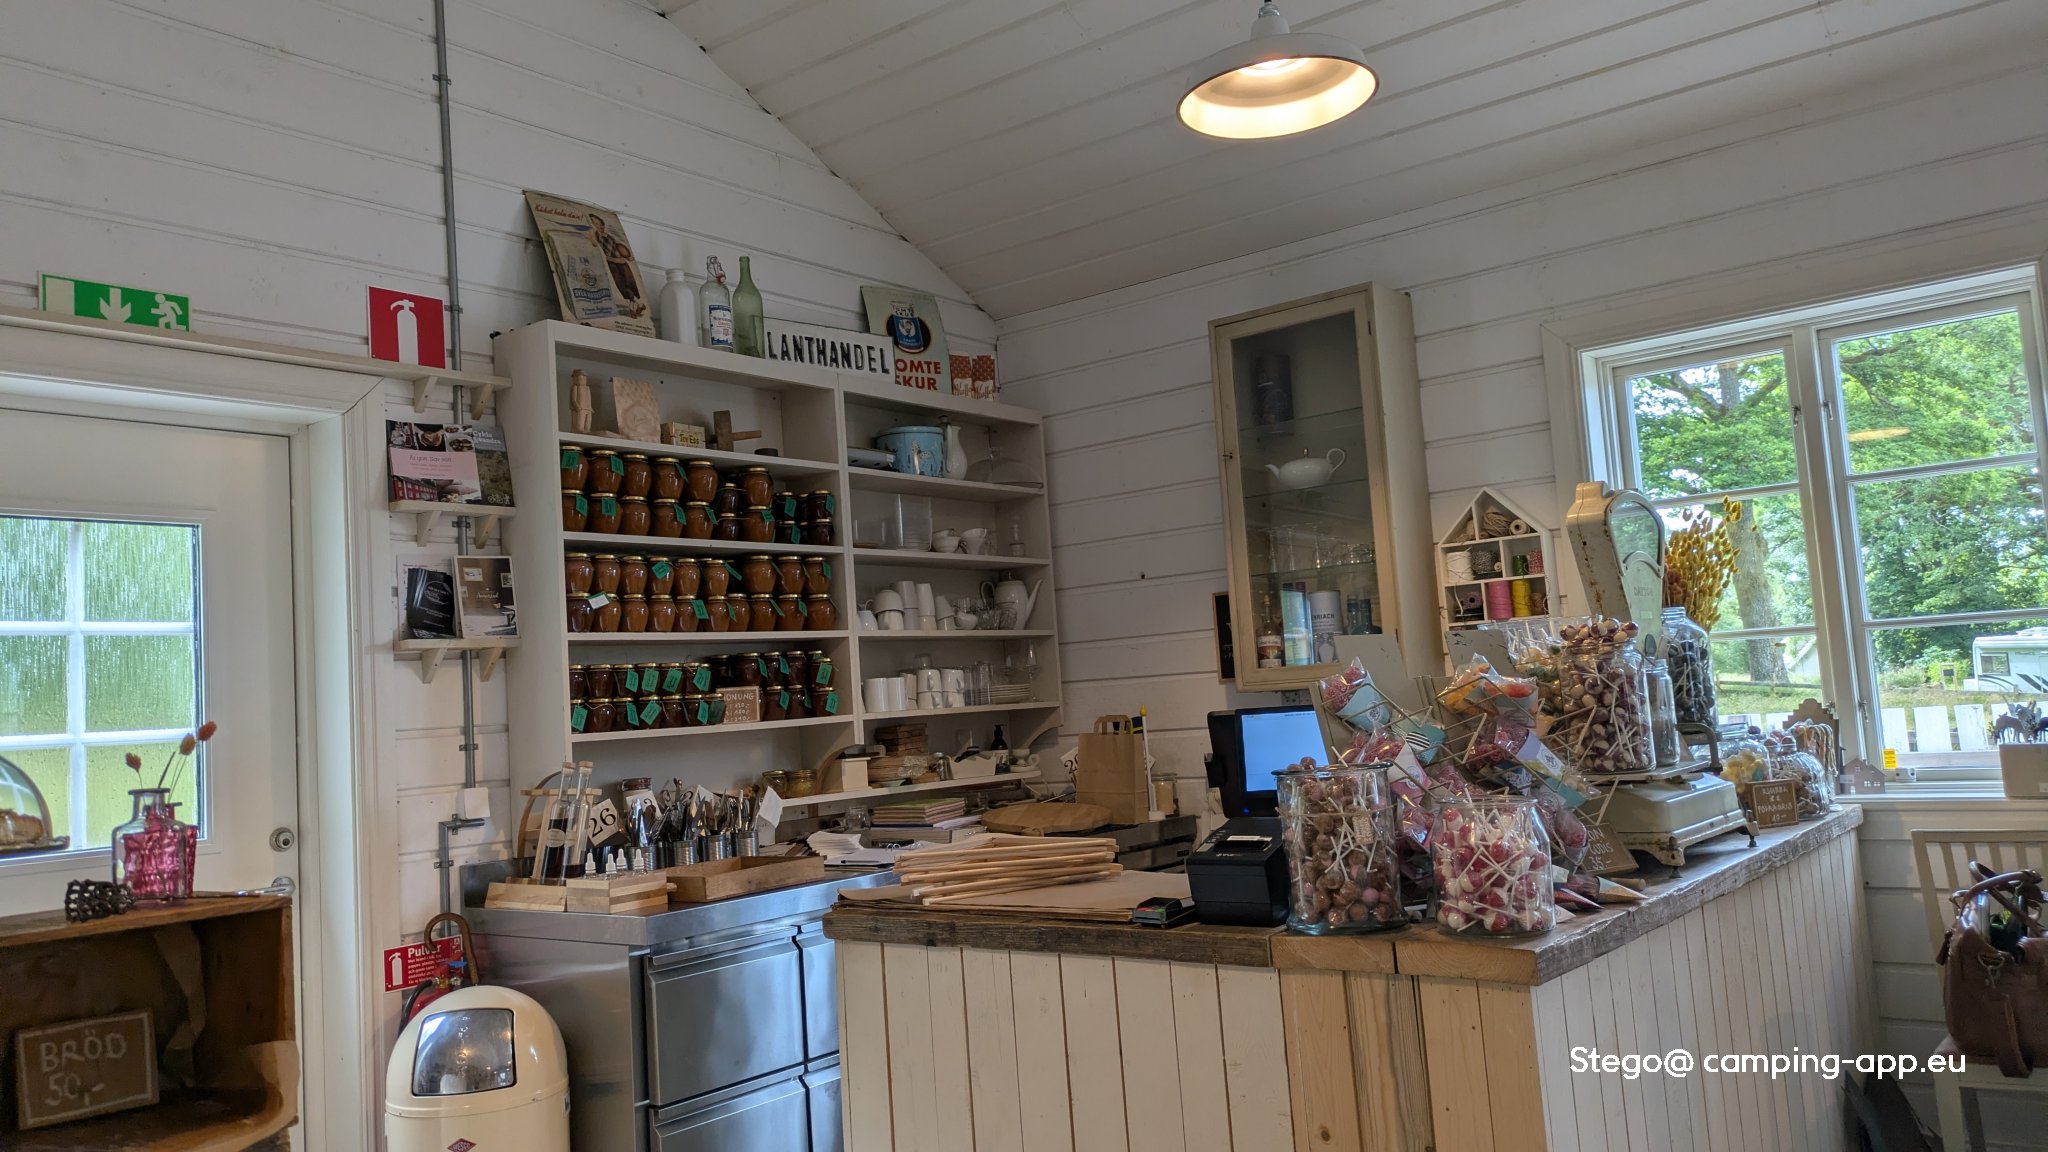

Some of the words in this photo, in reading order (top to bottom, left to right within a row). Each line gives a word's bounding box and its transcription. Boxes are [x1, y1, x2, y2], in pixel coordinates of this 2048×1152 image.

[767, 332, 890, 374] LANTHANDEL
[895, 359, 942, 375] OMTE
[589, 807, 617, 838] 26
[40, 1029, 127, 1073] BRÖD
